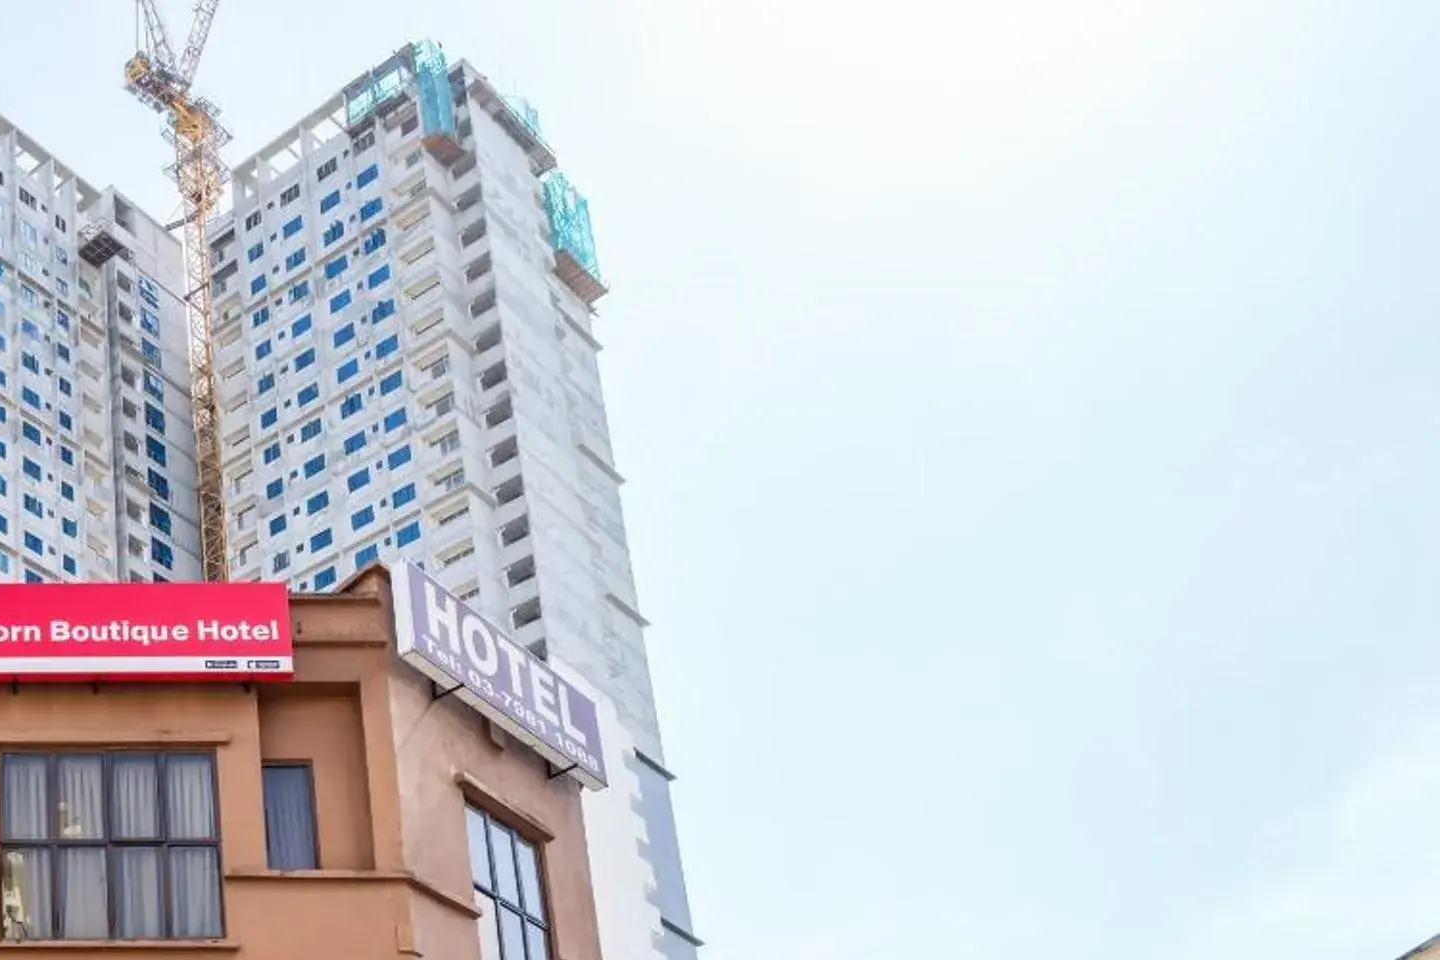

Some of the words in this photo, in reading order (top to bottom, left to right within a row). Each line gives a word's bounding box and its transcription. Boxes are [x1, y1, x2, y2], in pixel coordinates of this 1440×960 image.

[50, 620, 189, 645] Boutique
[197, 620, 279, 641] Hotel
[425, 580, 587, 747] HOTEL
